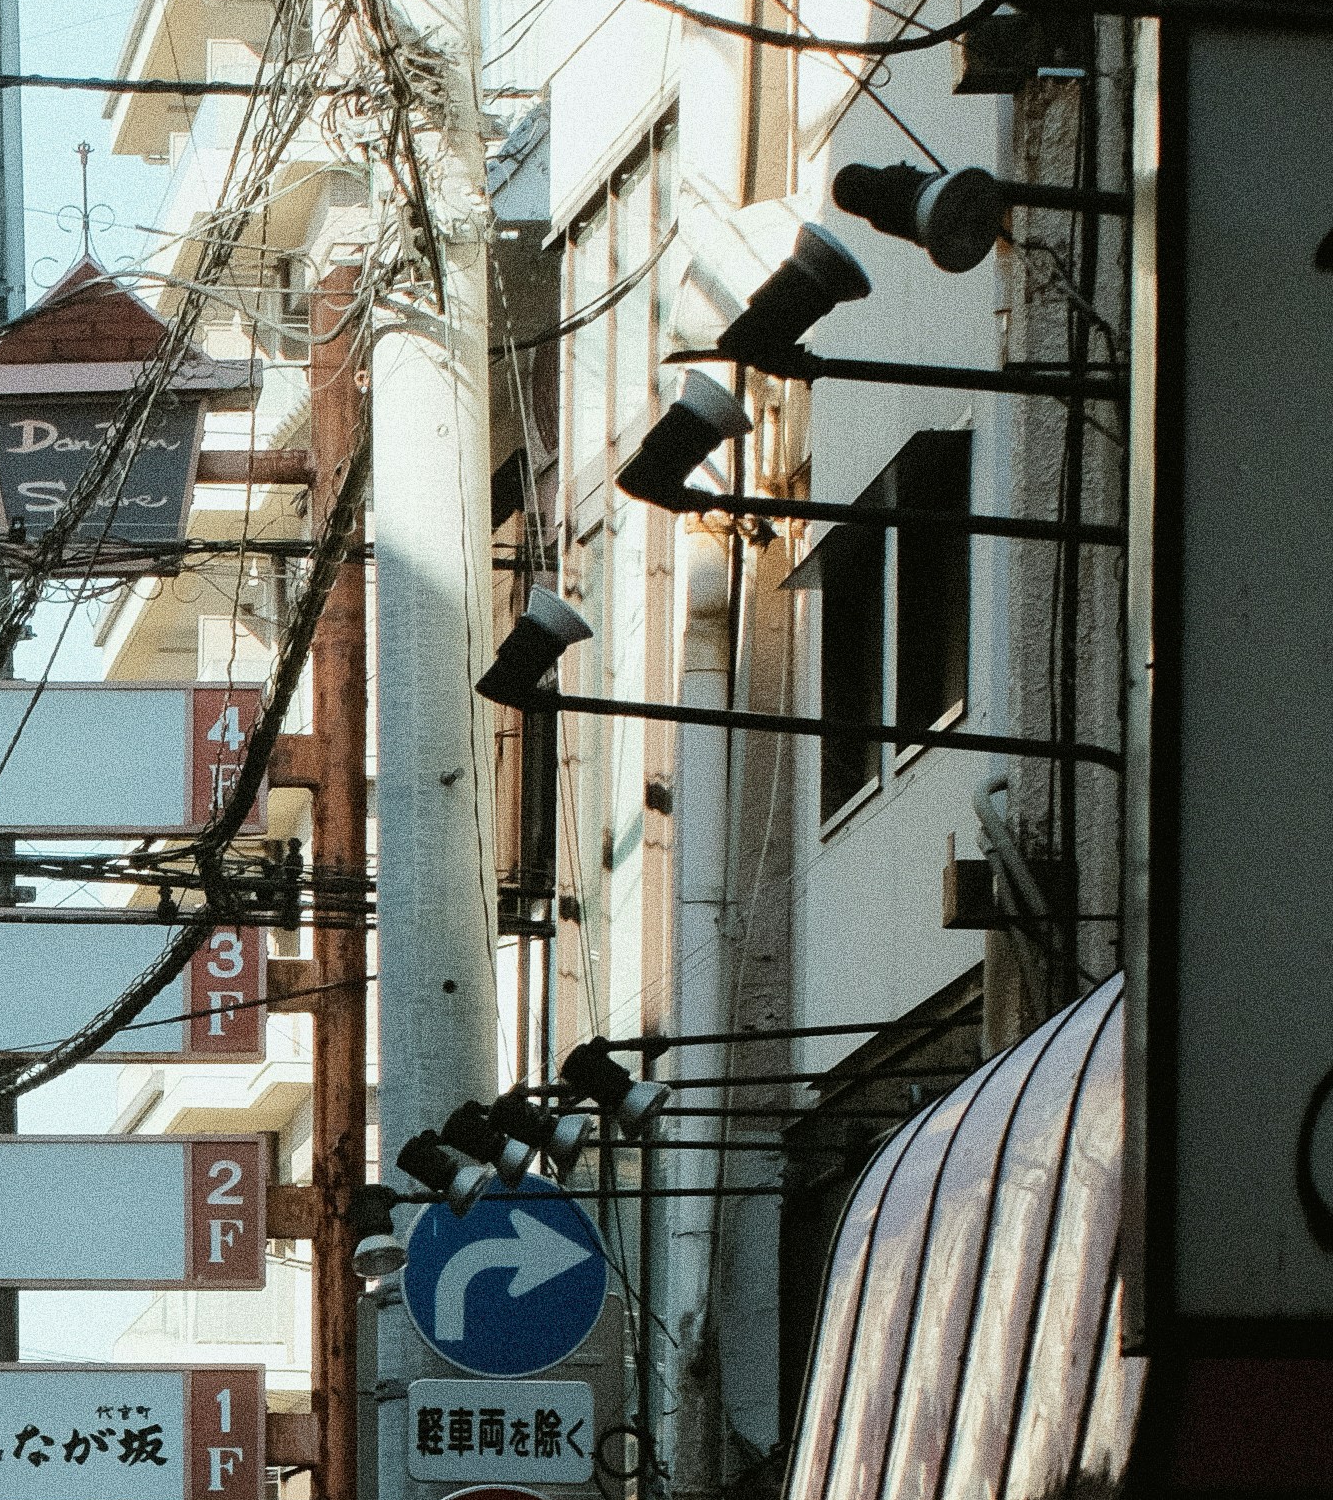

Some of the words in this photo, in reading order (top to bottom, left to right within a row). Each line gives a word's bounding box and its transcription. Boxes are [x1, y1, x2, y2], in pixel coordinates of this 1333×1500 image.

[13, 1423, 169, 1467] なが坂
[417, 1406, 587, 1459] 軽車両を除く
